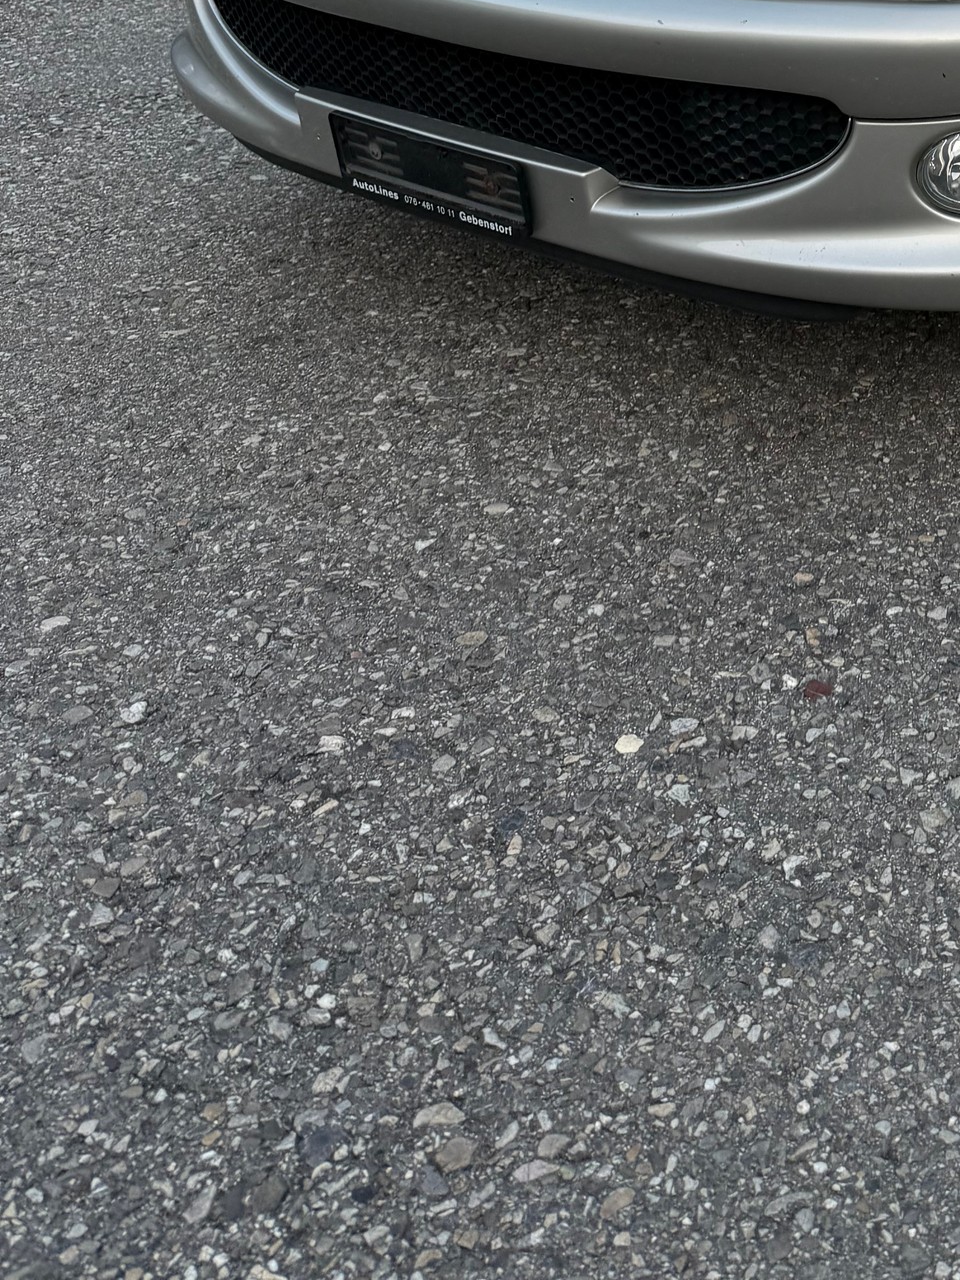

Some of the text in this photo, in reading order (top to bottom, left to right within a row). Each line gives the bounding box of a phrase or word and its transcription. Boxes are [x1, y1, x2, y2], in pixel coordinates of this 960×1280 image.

[352, 178, 400, 200] AutoLines
[436, 205, 446, 215] 10
[447, 208, 455, 218] 11
[459, 210, 513, 236] Gebenstorf
